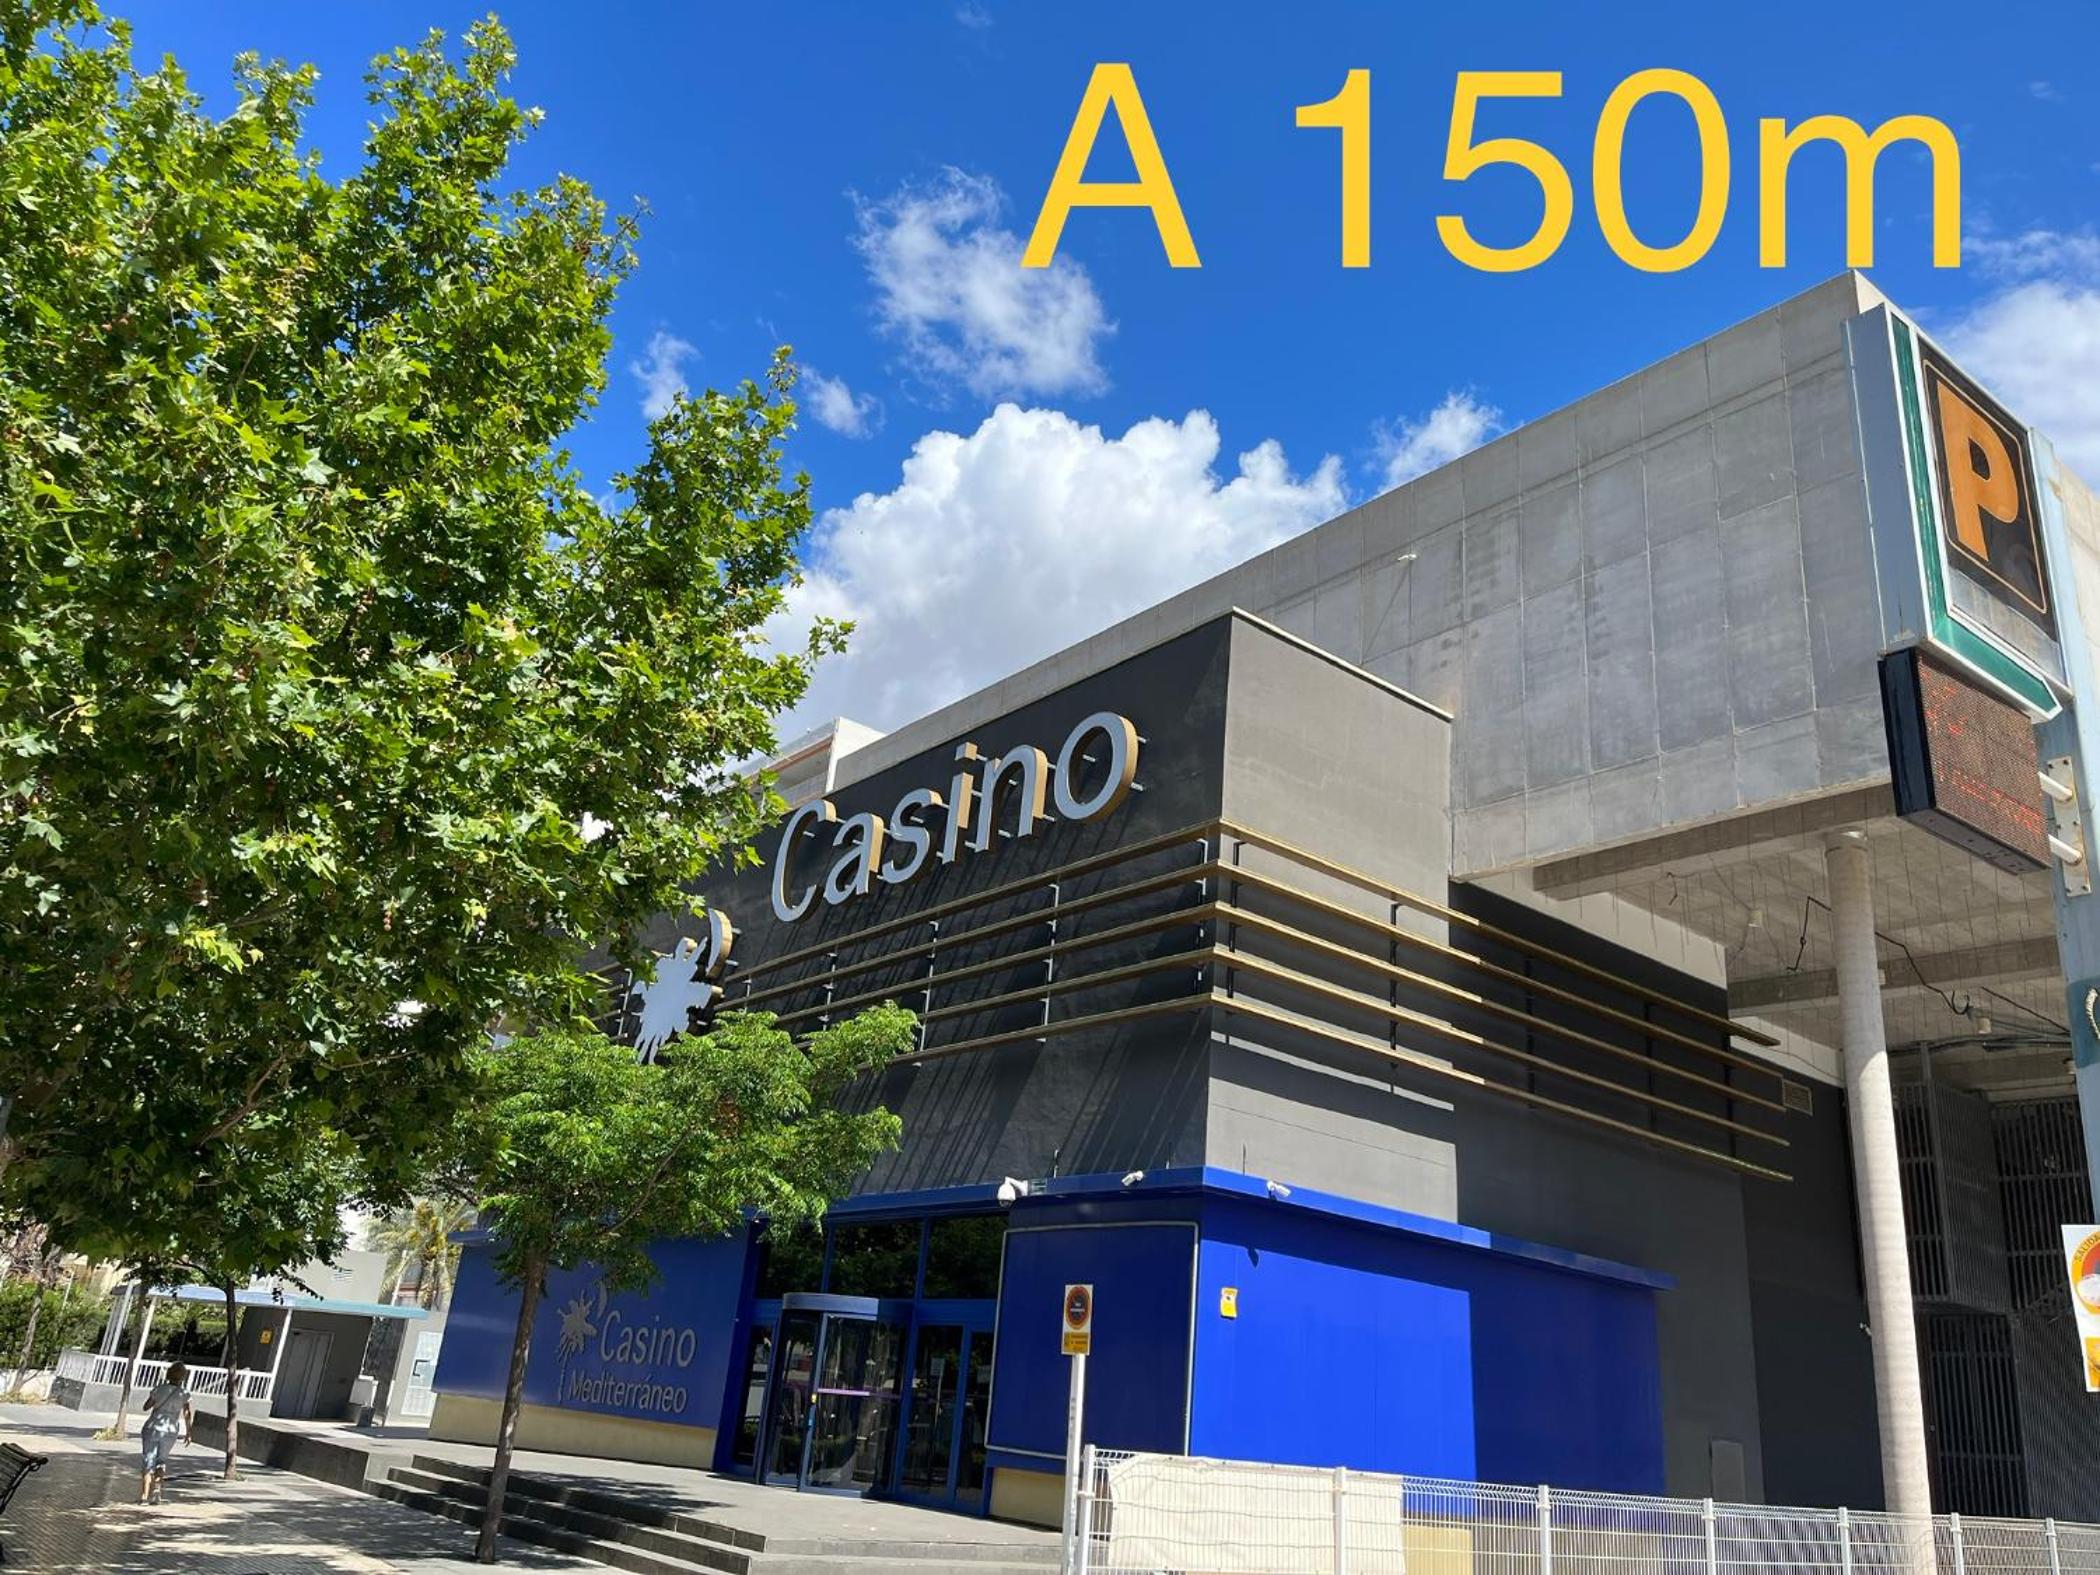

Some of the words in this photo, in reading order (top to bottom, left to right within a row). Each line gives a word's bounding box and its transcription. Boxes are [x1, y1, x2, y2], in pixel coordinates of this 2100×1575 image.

[1936, 379, 2020, 562] P
[771, 711, 1139, 922] Casino
[569, 1367, 688, 1414] Mediterráneo
[601, 1309, 697, 1368] Casino
